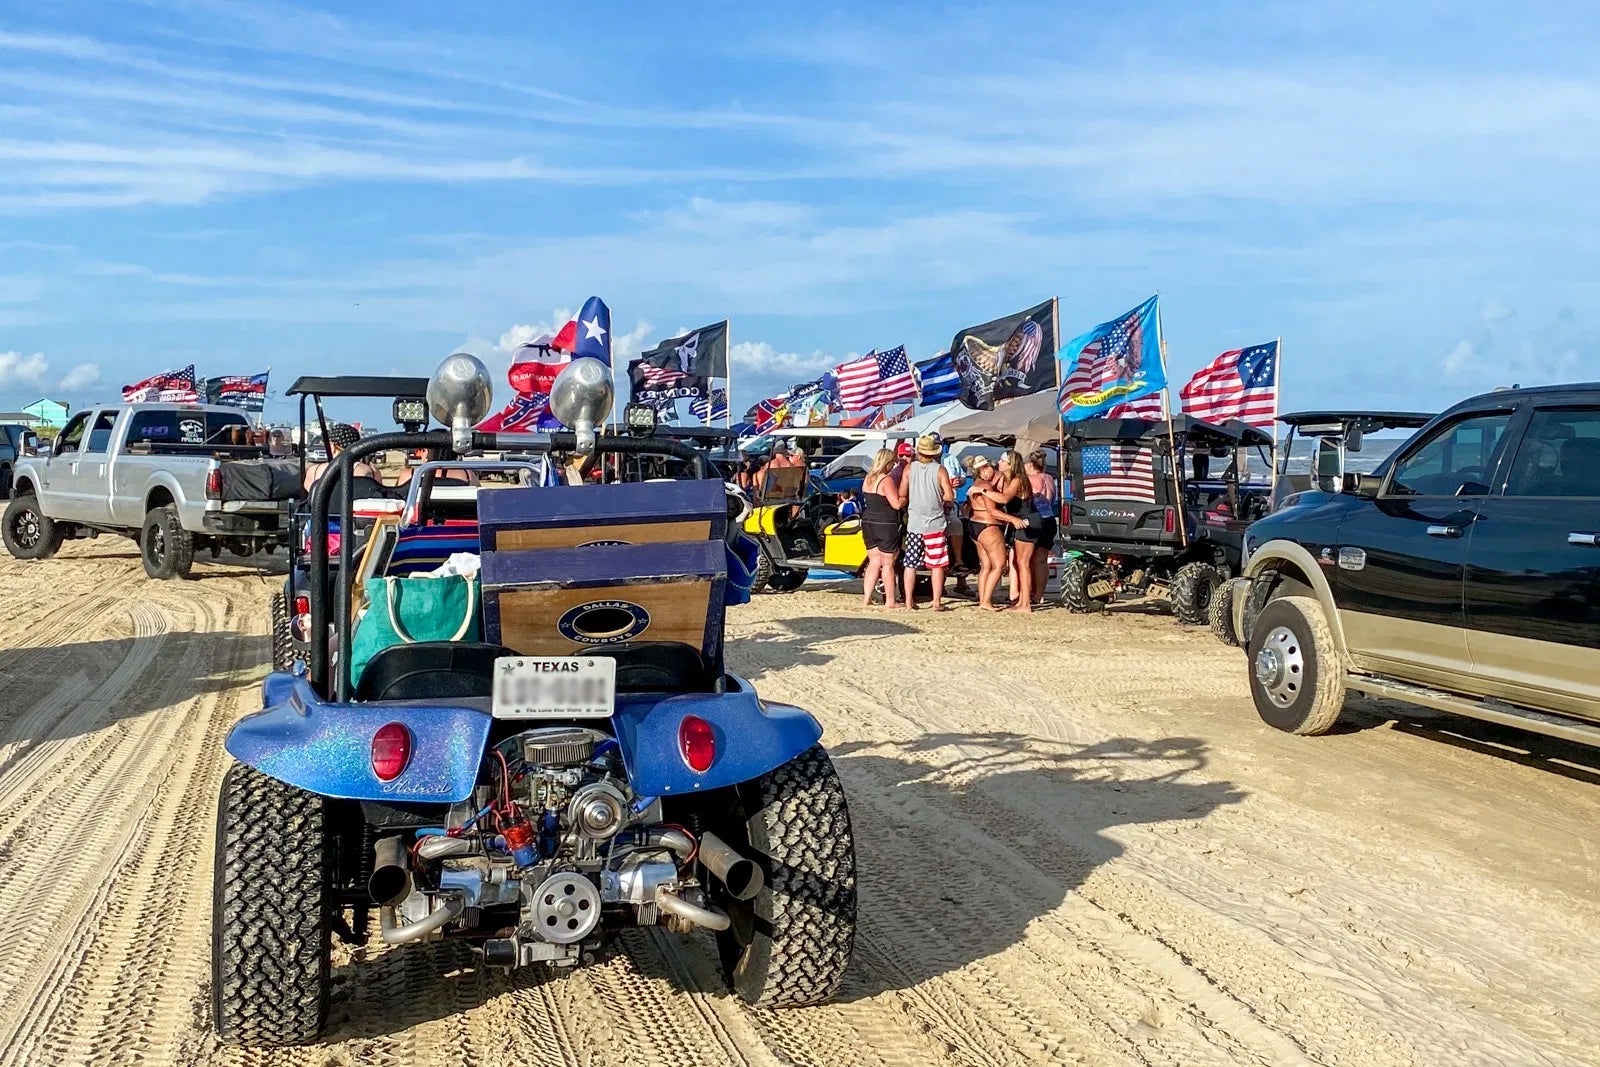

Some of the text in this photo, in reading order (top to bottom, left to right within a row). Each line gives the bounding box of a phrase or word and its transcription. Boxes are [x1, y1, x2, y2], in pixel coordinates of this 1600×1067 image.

[583, 602, 629, 610] DALLAS
[574, 633, 632, 643] COWBOYS
[533, 661, 579, 673] TEXAS
